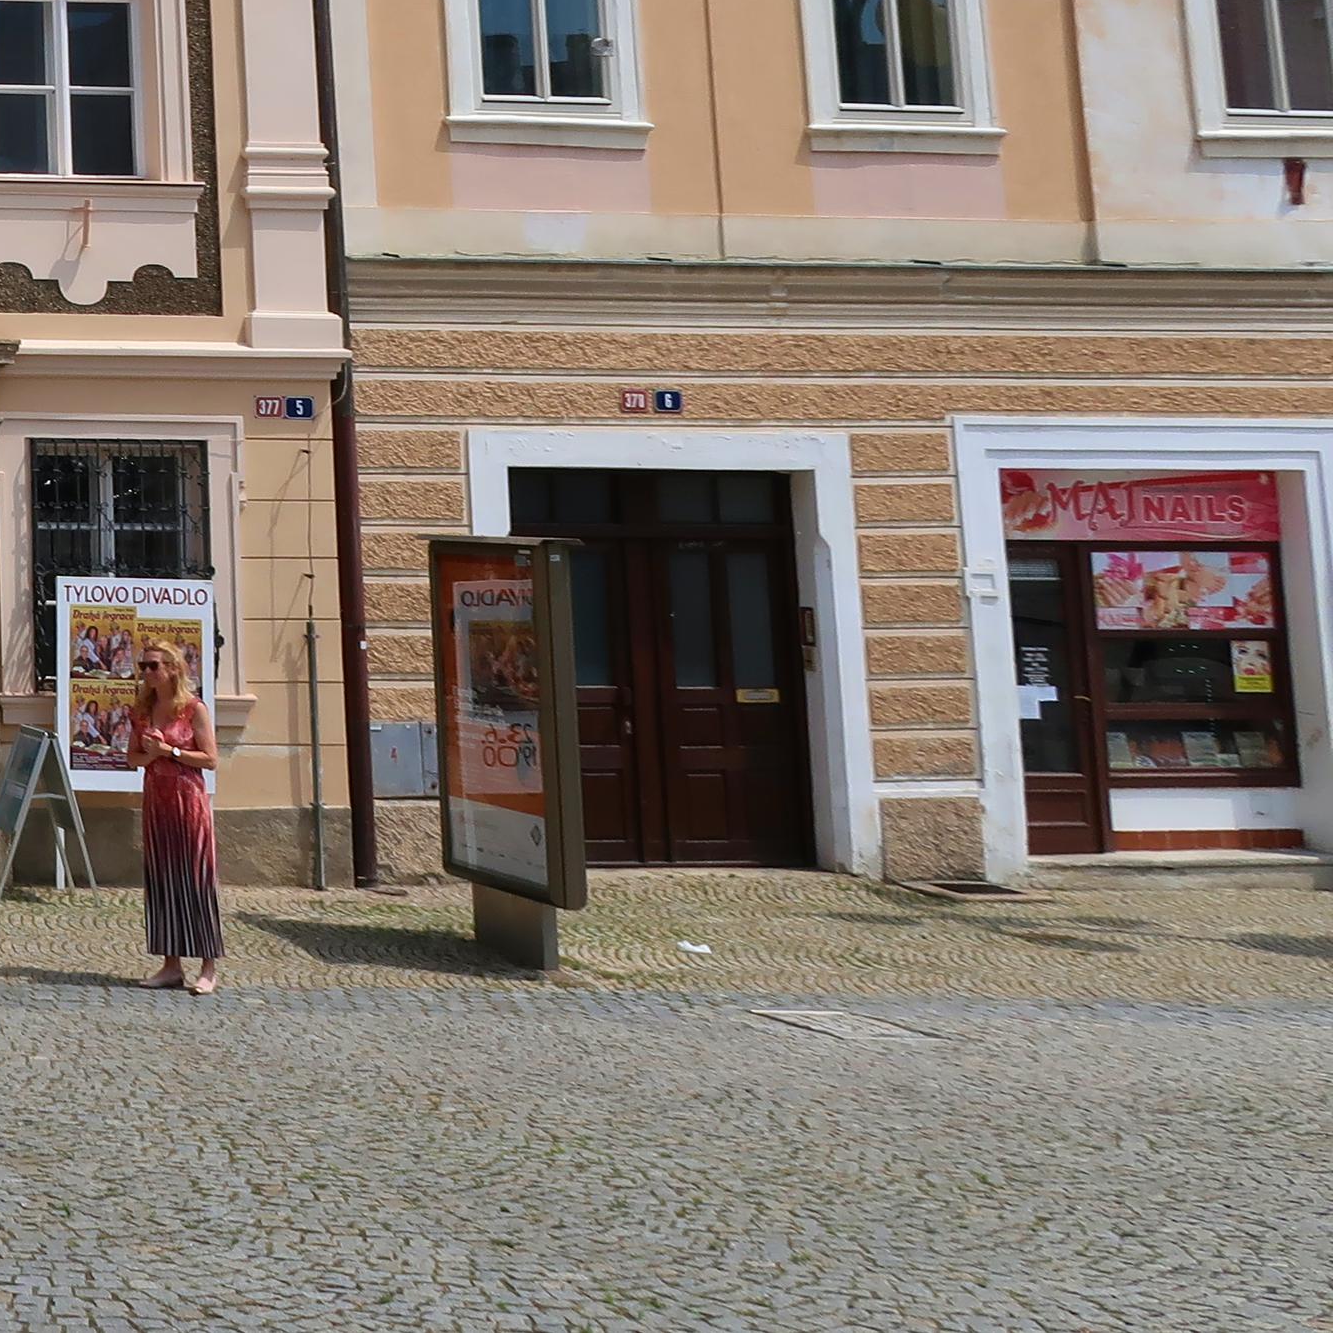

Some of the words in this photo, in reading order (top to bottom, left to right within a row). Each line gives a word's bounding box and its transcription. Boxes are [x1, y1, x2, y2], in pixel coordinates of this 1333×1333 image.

[258, 399, 280, 415] 377
[295, 399, 304, 416] 5
[664, 393, 673, 409] 6
[1141, 494, 1248, 525] NAILS
[64, 584, 130, 604] TYLOVO
[133, 586, 209, 606] DIVADLO
[72, 608, 101, 621] Drahá
[102, 609, 134, 621] legrace
[72, 682, 101, 697] Drahá
